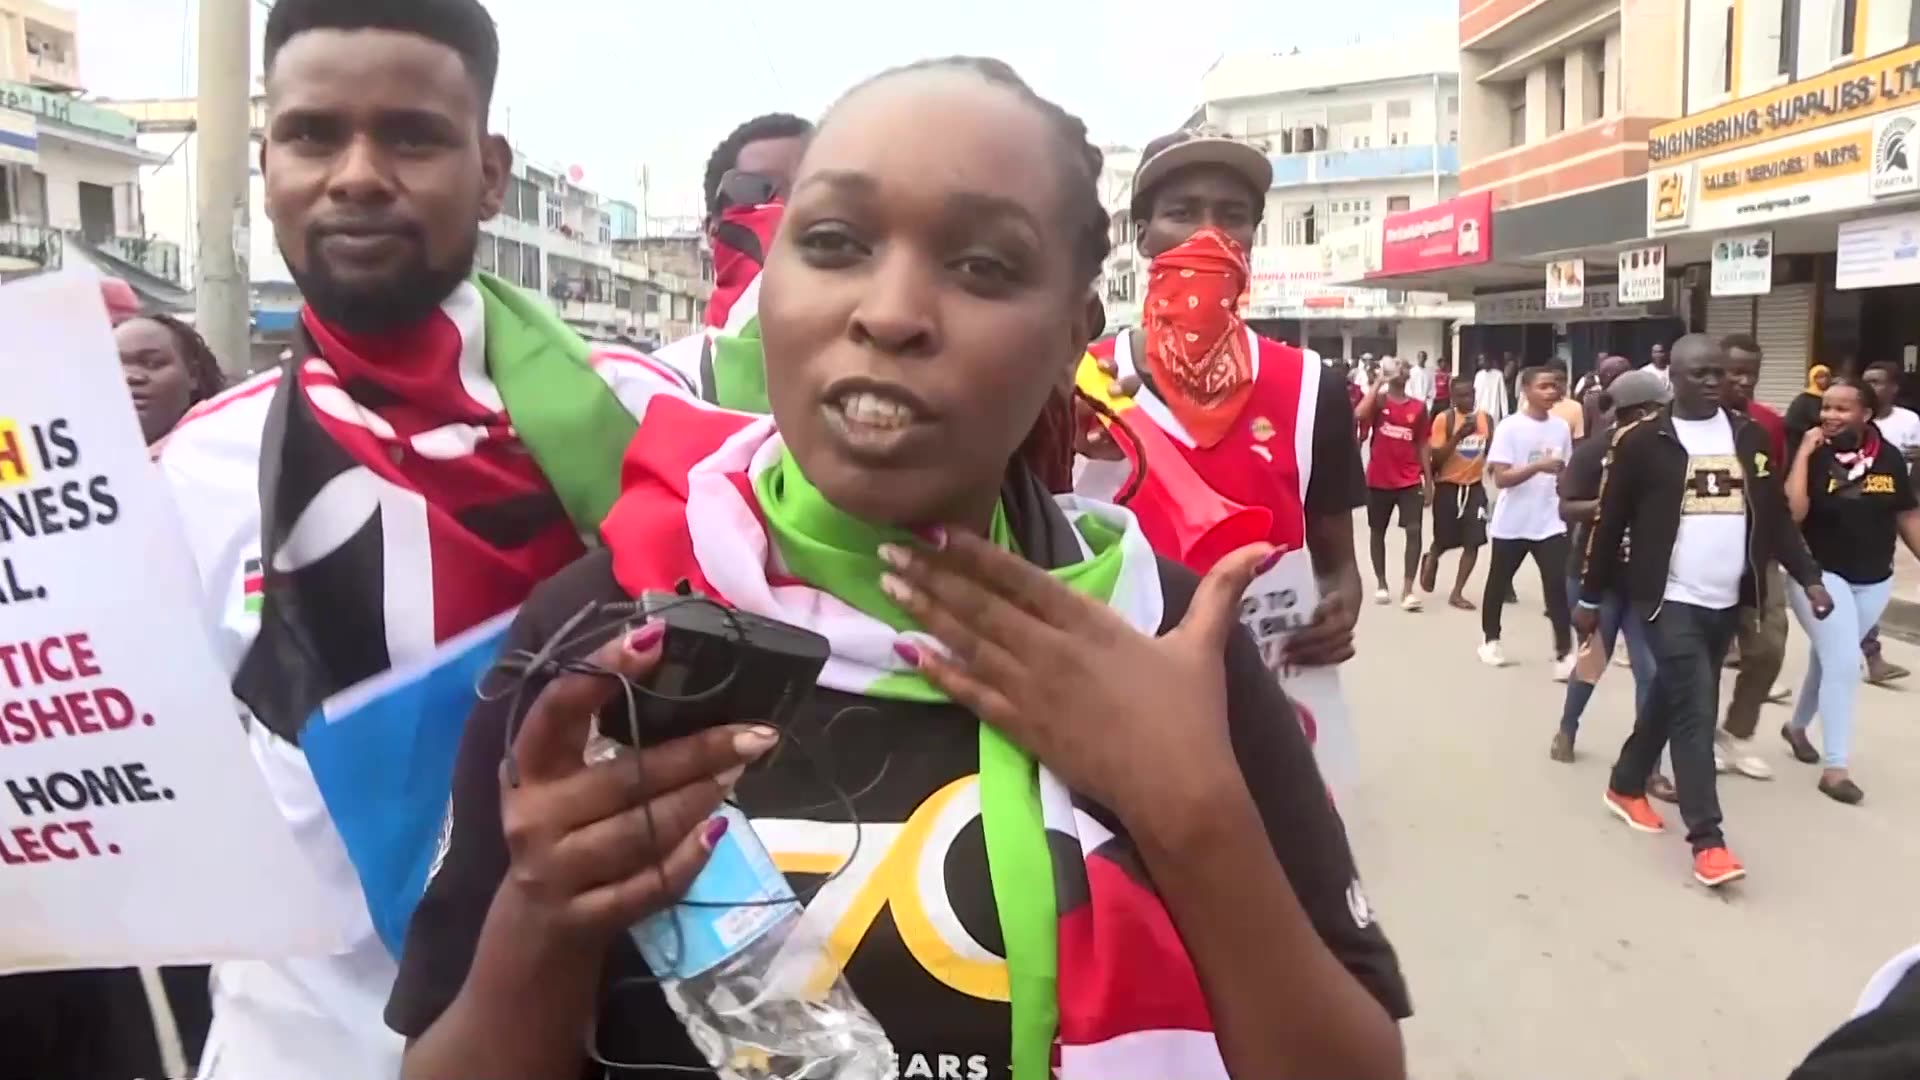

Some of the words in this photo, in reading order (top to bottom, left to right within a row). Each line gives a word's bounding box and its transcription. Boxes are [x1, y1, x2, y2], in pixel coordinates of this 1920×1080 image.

[1649, 108, 1761, 161] ENGINEERING
[1766, 76, 1876, 129] SUPPLIES
[1704, 168, 1738, 191] SALES
[1745, 156, 1804, 183] SERVICES
[1814, 143, 1861, 168] PARTS
[31, 418, 80, 471] IS
[0, 475, 119, 542] NESS
[0, 632, 102, 688] TICE
[5, 761, 175, 816] HOME.
[0, 820, 121, 866] LECT.
